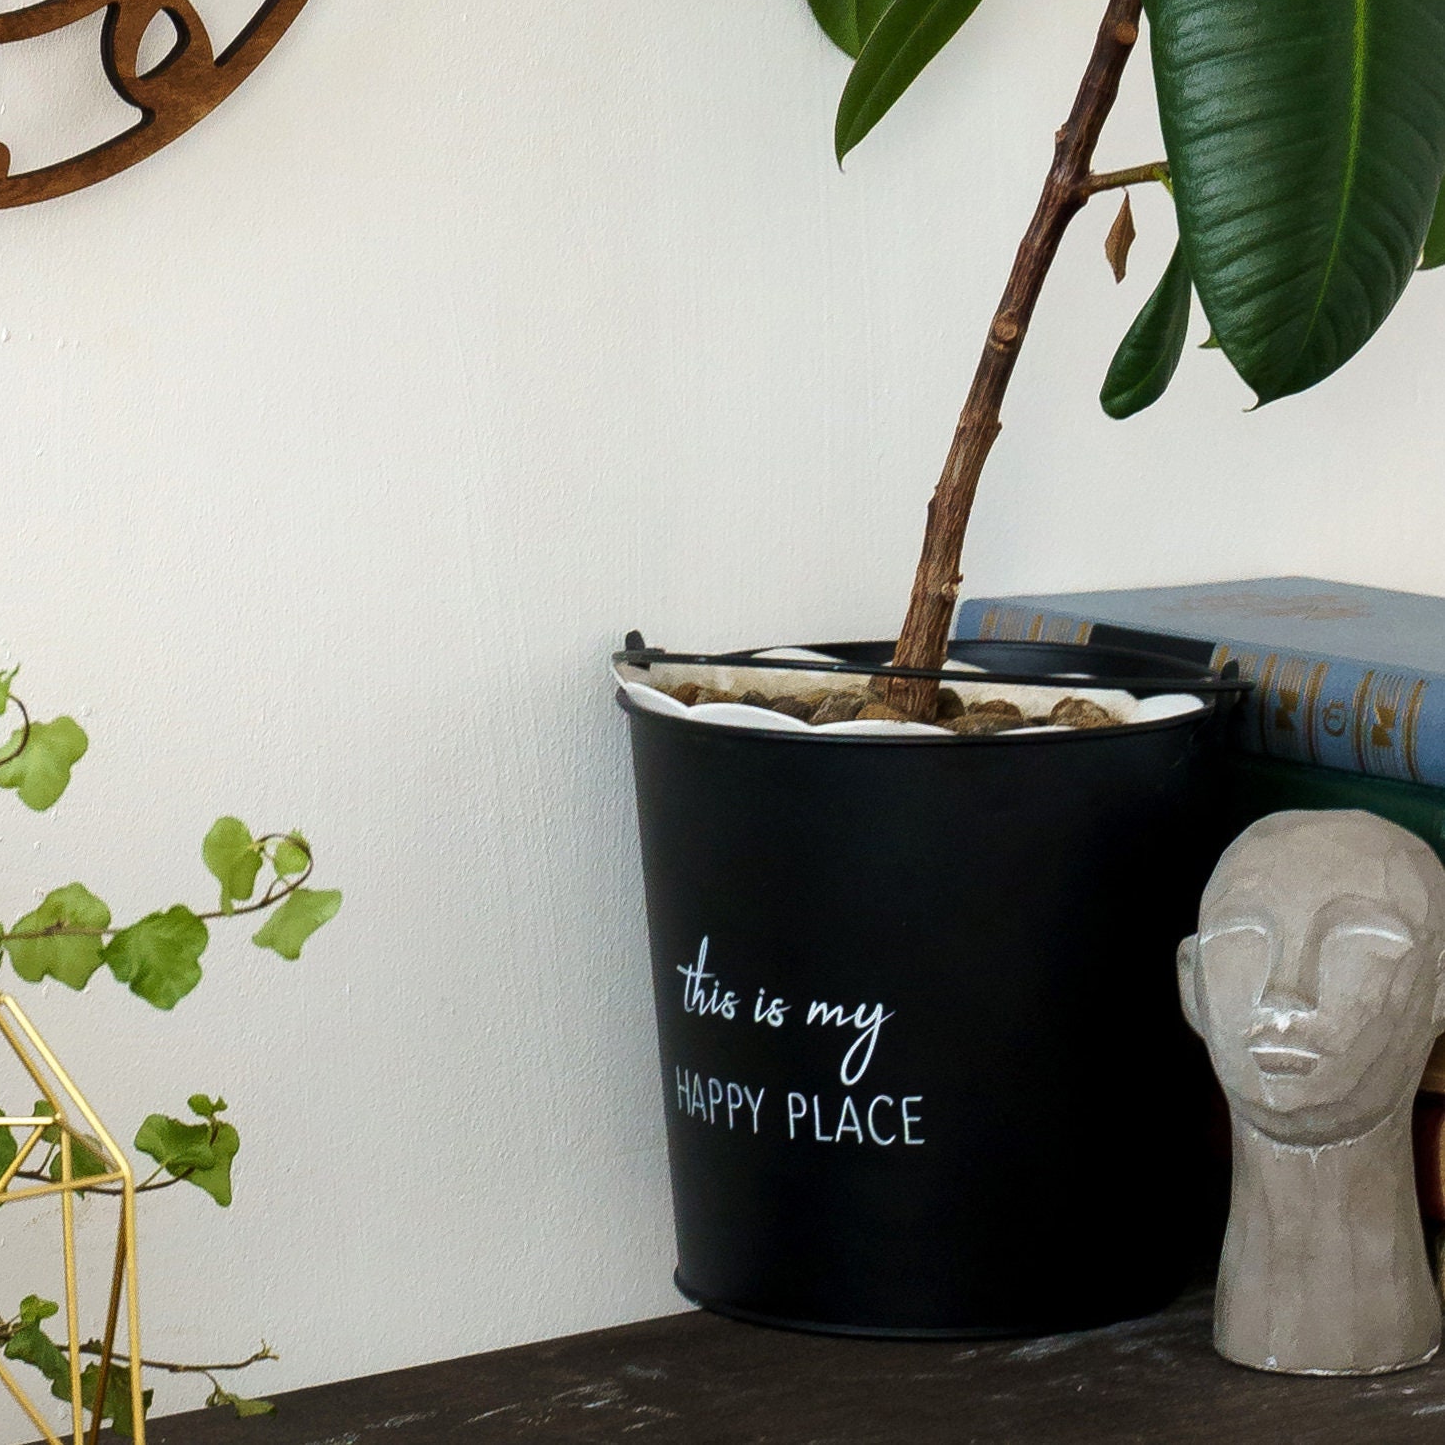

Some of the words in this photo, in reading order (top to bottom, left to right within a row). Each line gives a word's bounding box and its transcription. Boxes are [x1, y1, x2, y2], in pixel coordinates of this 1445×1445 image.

[675, 934, 741, 1021] this
[753, 987, 793, 1028] is
[805, 999, 897, 1087] my
[674, 1064, 765, 1135] HAPPY
[787, 1091, 926, 1146] PLACE
